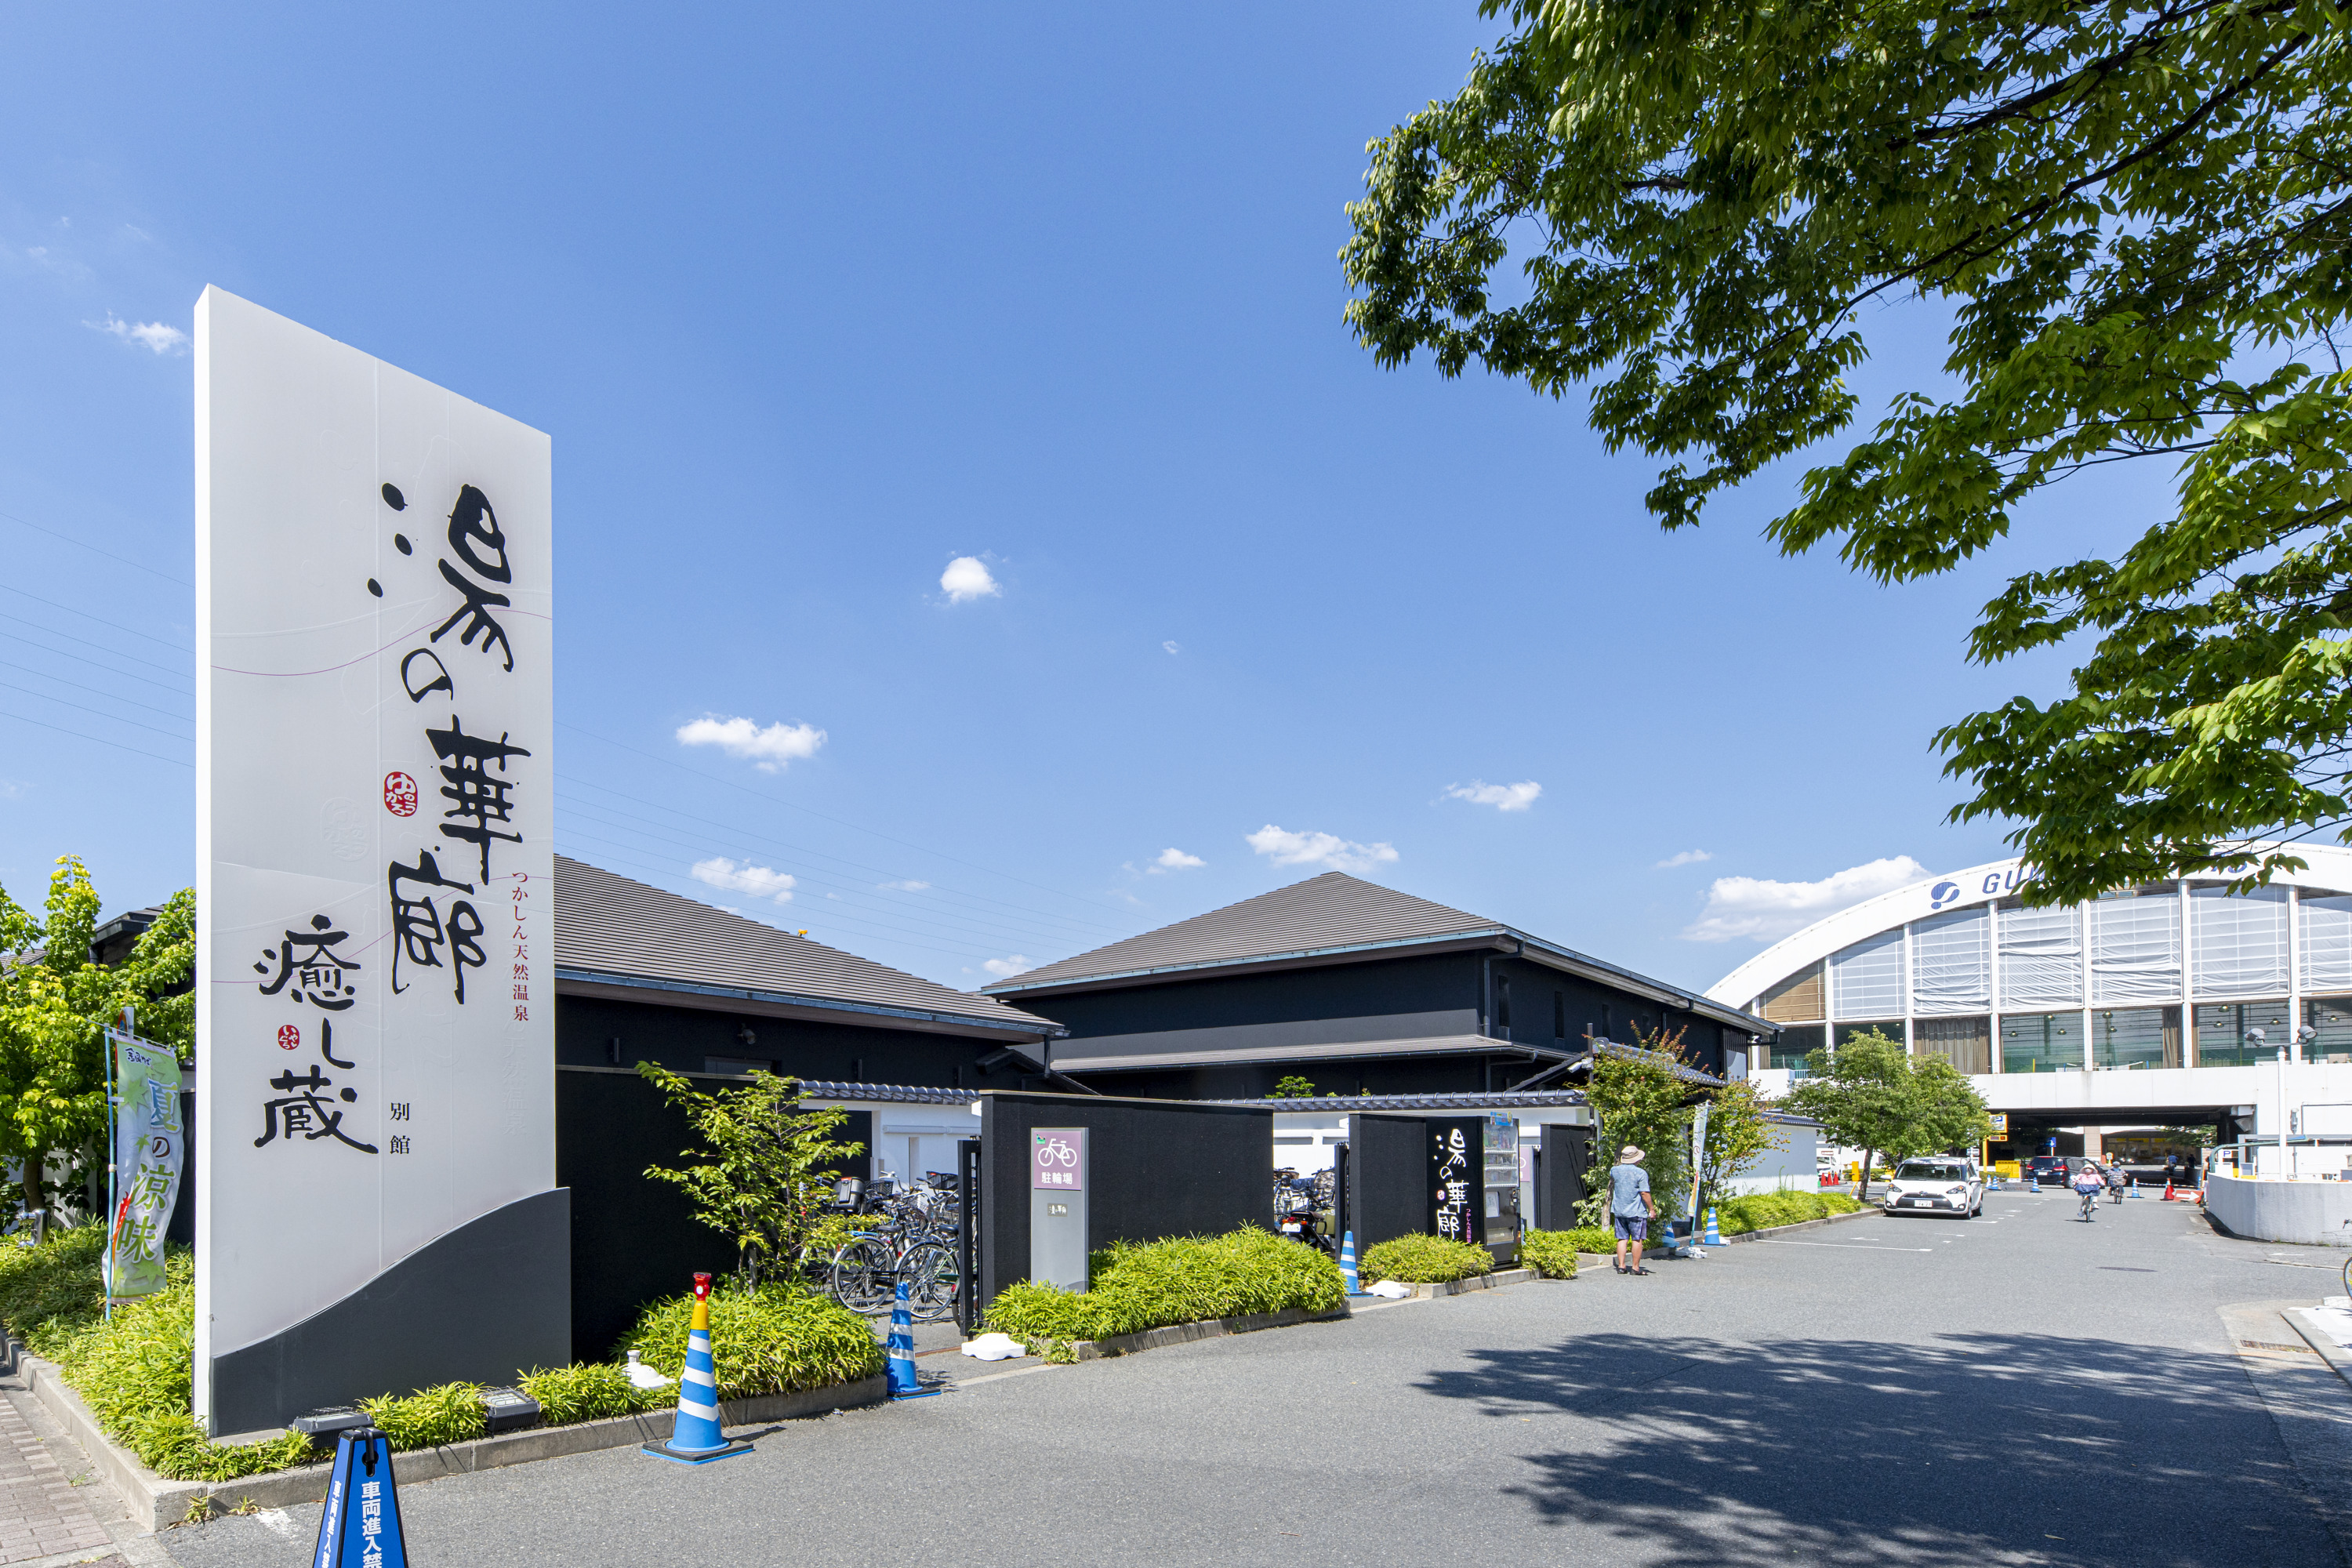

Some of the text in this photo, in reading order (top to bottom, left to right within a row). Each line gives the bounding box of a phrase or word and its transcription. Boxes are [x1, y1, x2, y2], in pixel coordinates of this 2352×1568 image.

[368, 484, 531, 1004] 湯の華廊
[510, 872, 530, 1022] つかしん天然温泉
[253, 914, 379, 1154] 癒し蔵
[116, 1079, 180, 1262] 夏の涼味
[390, 1102, 410, 1155] 別館
[1041, 1171, 1073, 1185] 駐輪場
[1433, 1128, 1469, 1240] 湯の華廊
[361, 1481, 383, 1568] 車両進入禁
